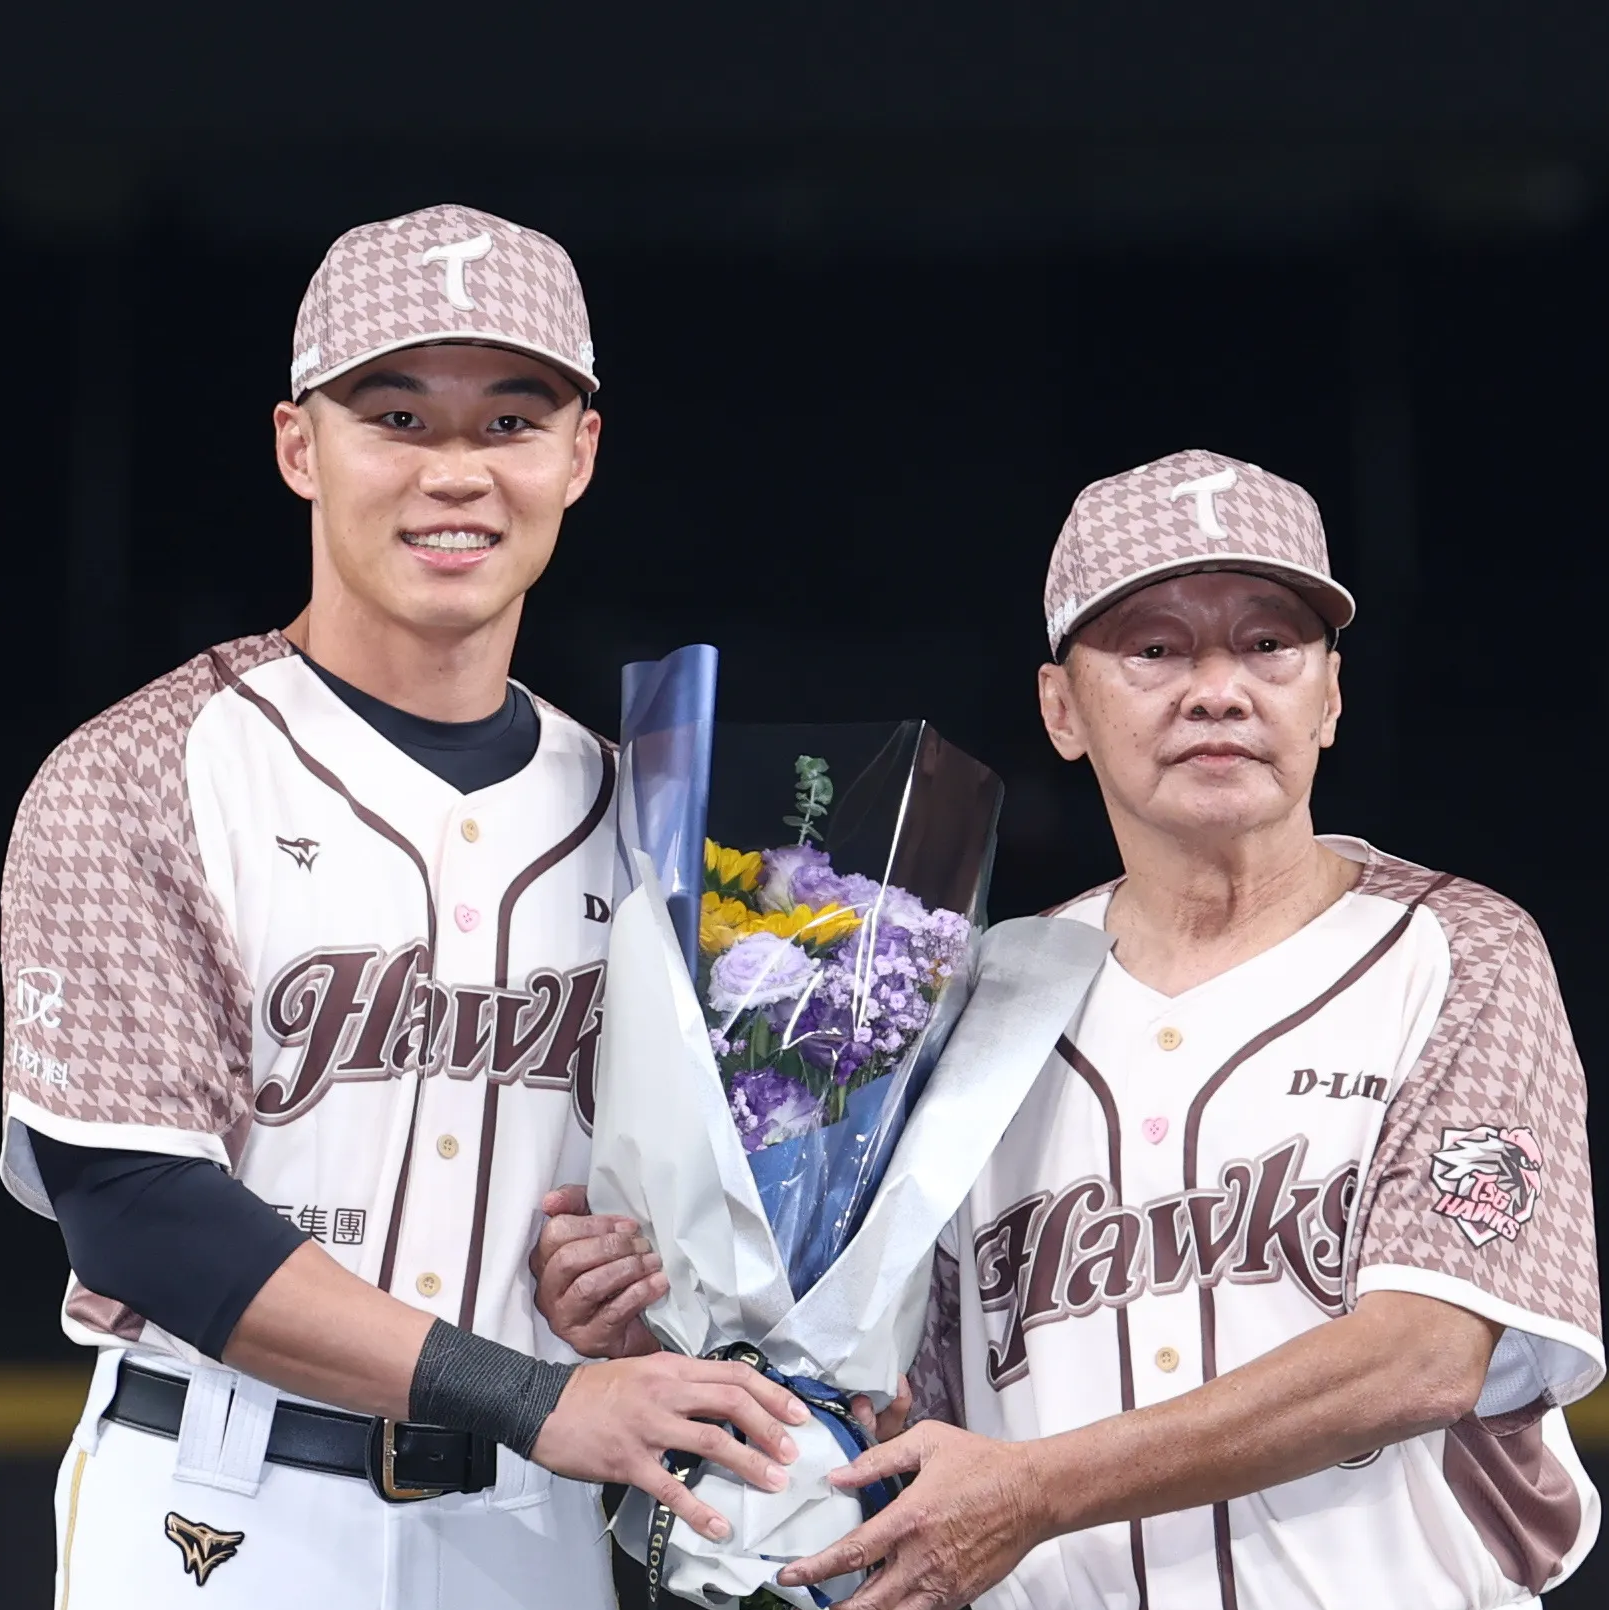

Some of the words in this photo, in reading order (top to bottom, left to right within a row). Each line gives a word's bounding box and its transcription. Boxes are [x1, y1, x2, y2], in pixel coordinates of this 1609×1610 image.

[254, 937, 608, 1138] Hawk
[13, 1038, 69, 1091] 材料
[1286, 1067, 1389, 1105] D-Lin
[1470, 1171, 1512, 1212] TSG
[1434, 1192, 1521, 1241] HAWKS
